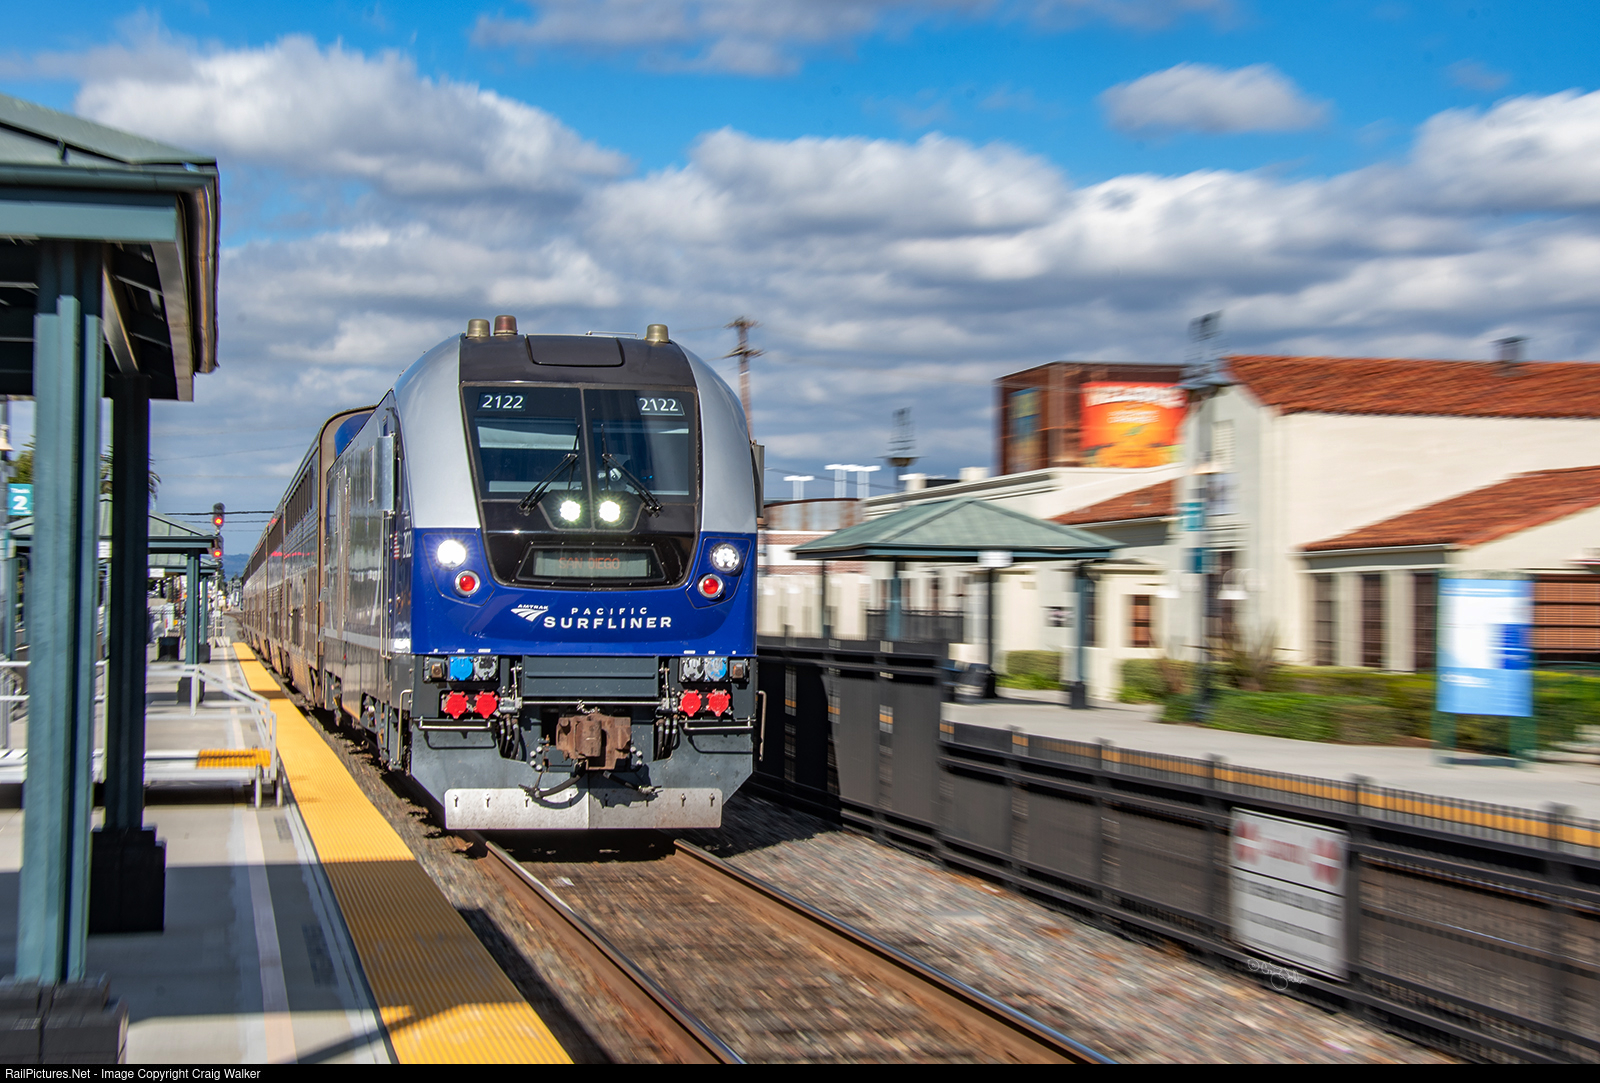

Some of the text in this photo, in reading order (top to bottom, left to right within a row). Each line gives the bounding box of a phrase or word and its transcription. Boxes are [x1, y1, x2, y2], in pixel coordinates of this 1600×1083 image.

[482, 395, 524, 409] 2122
[639, 398, 679, 411] 2122
[13, 496, 28, 510] 2
[558, 557, 620, 569] SAN DIEGO
[571, 607, 648, 615] PACIFIC
[543, 616, 672, 629] SURFLINER
